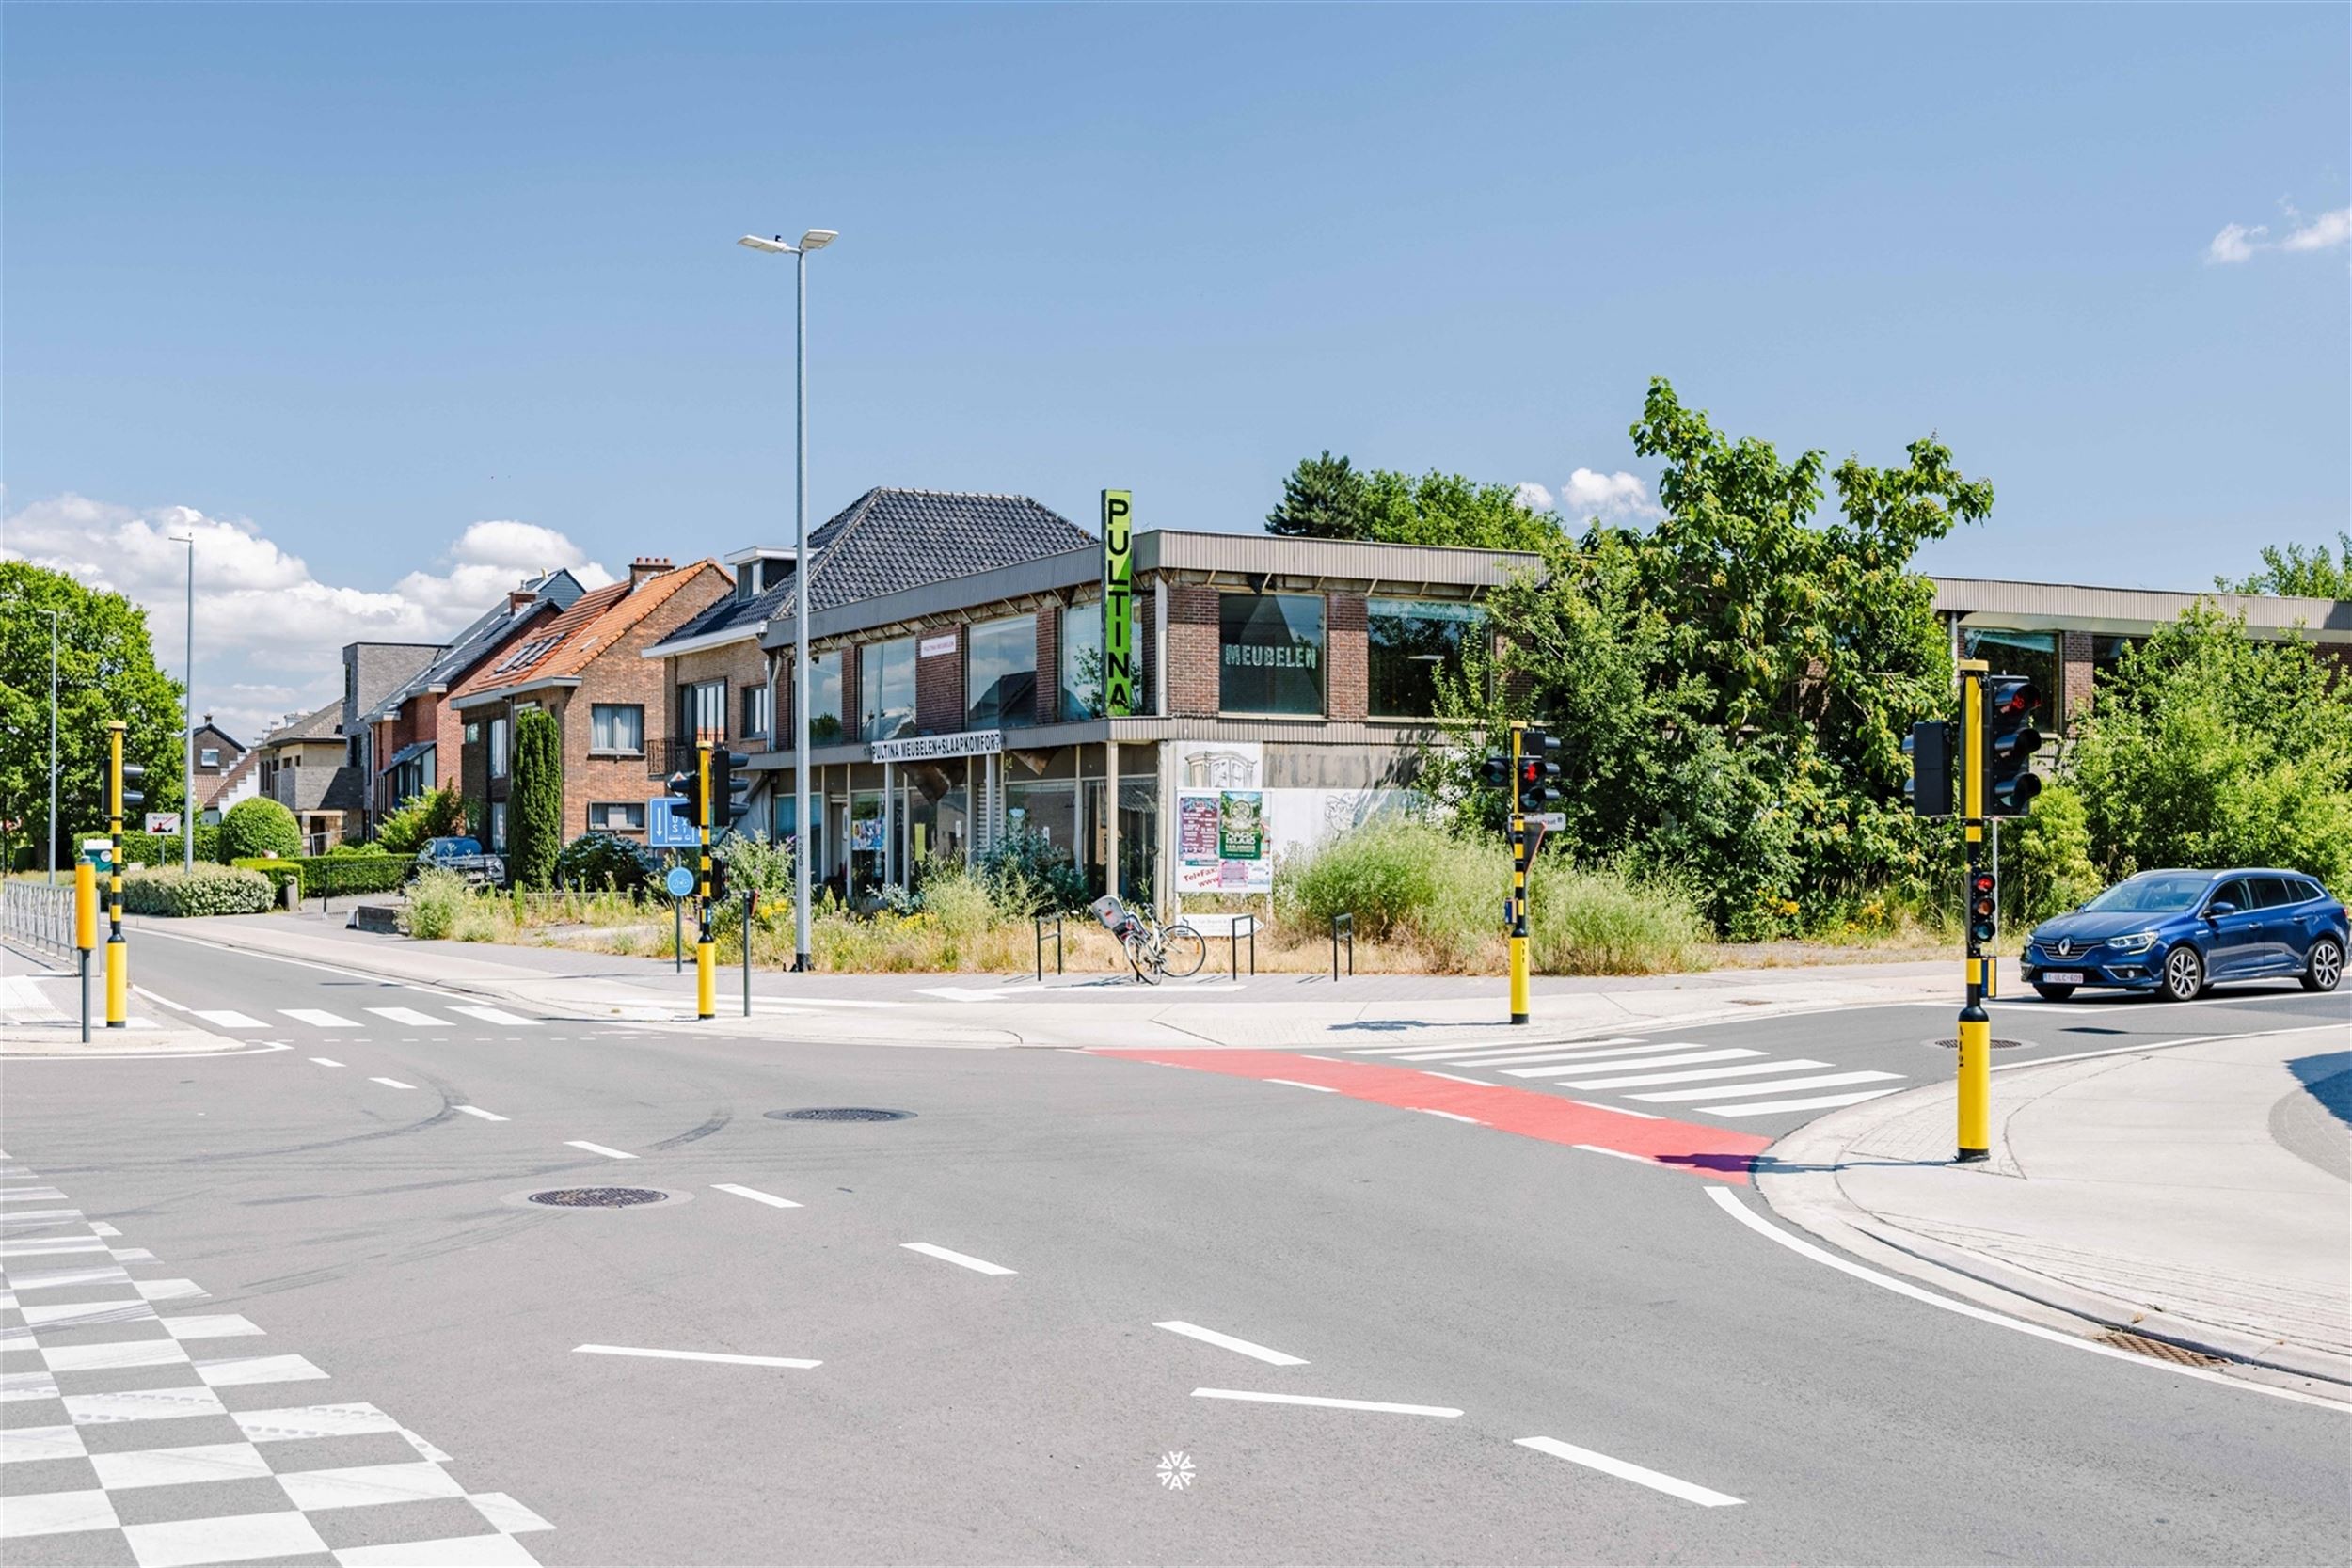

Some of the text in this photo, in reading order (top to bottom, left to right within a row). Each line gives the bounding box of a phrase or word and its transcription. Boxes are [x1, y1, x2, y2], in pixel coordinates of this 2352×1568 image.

[1107, 498, 1129, 708] PULTINA
[1225, 643, 1316, 670] MEUBELEN
[872, 744, 899, 760] PULTINA
